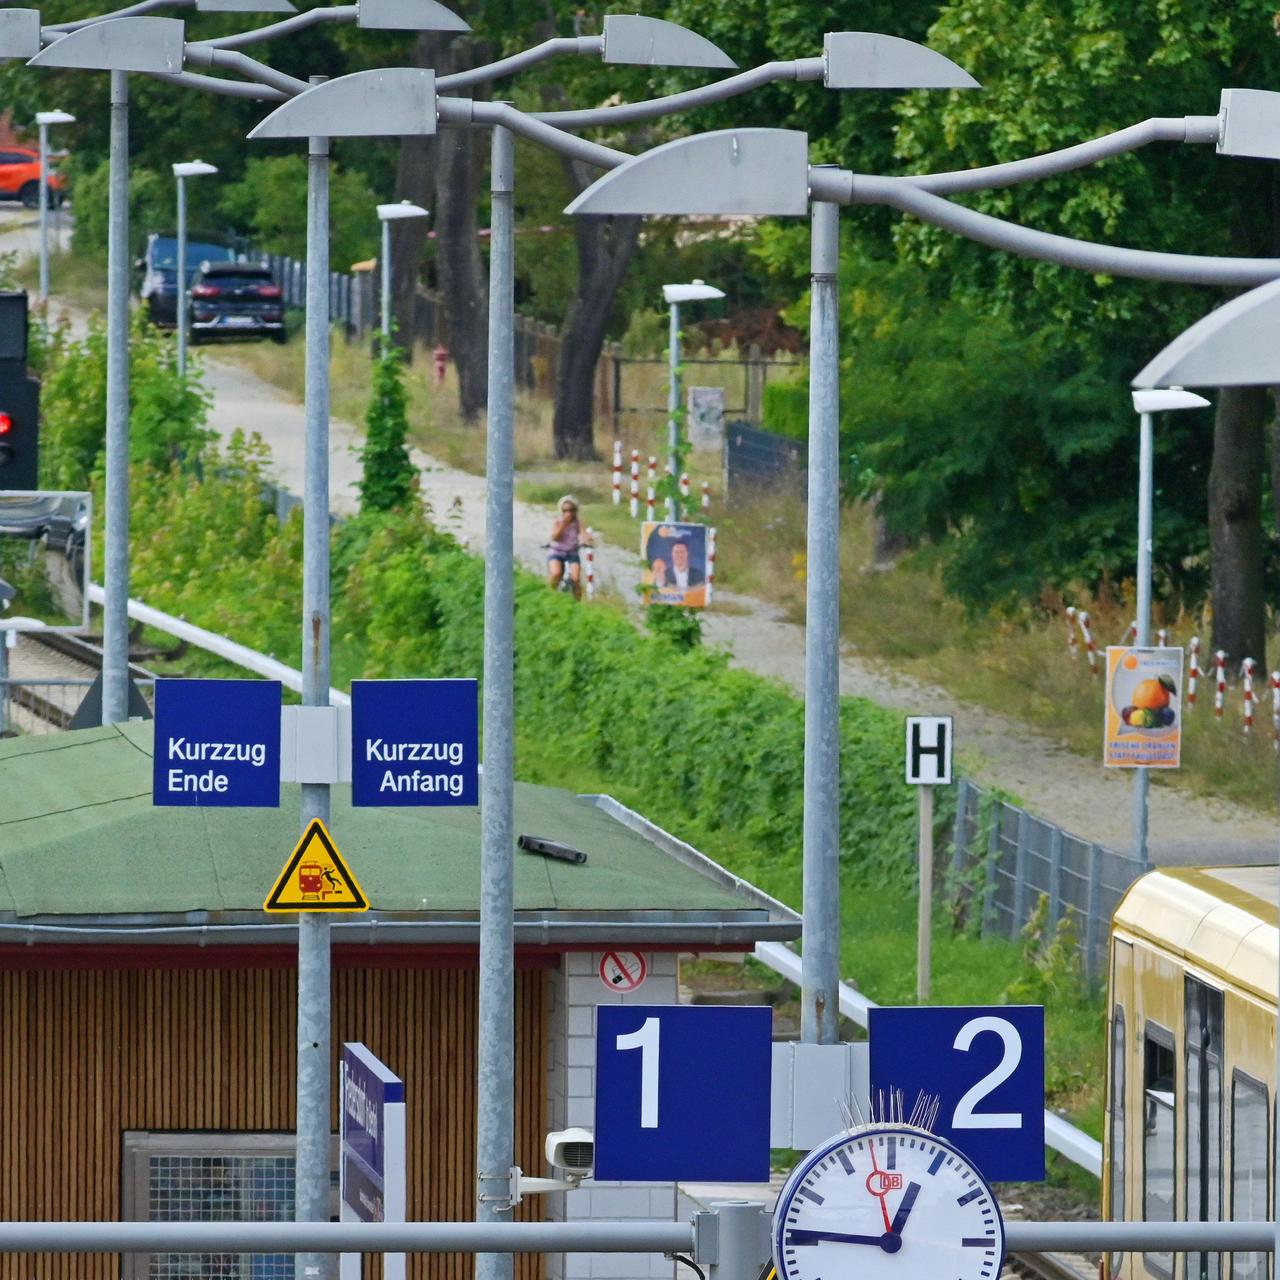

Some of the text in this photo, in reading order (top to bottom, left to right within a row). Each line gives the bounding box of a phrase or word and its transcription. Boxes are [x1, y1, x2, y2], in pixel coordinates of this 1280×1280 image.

[168, 738, 266, 766] Kurzzug
[366, 738, 463, 766] Kurzzug
[912, 723, 946, 778] H
[168, 769, 229, 792] Ende
[379, 769, 464, 796] Anfang
[616, 1017, 660, 1129] 1
[951, 1016, 1023, 1130] 2
